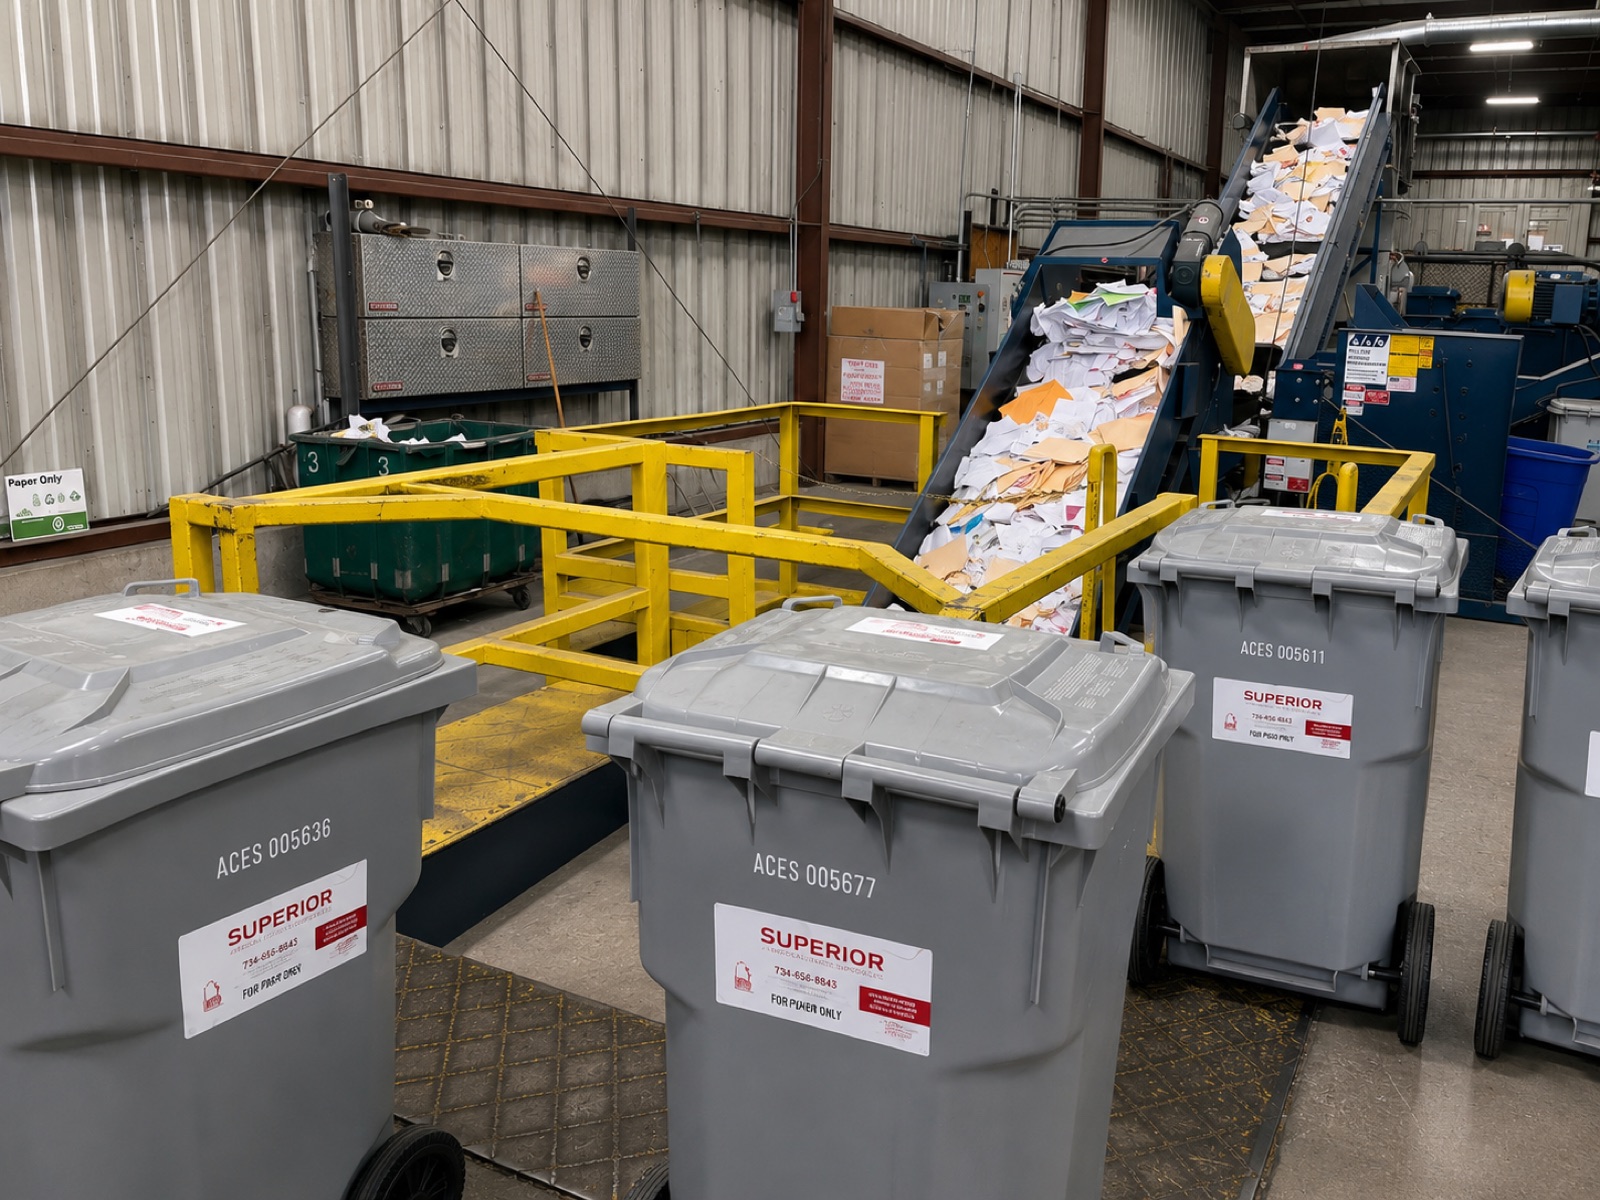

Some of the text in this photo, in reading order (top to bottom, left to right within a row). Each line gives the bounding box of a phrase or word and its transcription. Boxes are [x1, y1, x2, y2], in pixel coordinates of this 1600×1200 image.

[307, 451, 319, 473] 3
[378, 456, 389, 476] 3
[40, 474, 62, 484] Only
[1240, 640, 1325, 665] ACES 005611
[1243, 690, 1322, 711] SUPERIOR
[216, 817, 331, 880] ACES 005636
[753, 852, 876, 899] ACES 005677
[228, 888, 333, 947] SUPERIOR
[760, 927, 884, 972] SUPERIOR
[242, 983, 259, 1000] FOR
[770, 993, 788, 1008] FOR
[819, 1006, 842, 1021] ONLY
